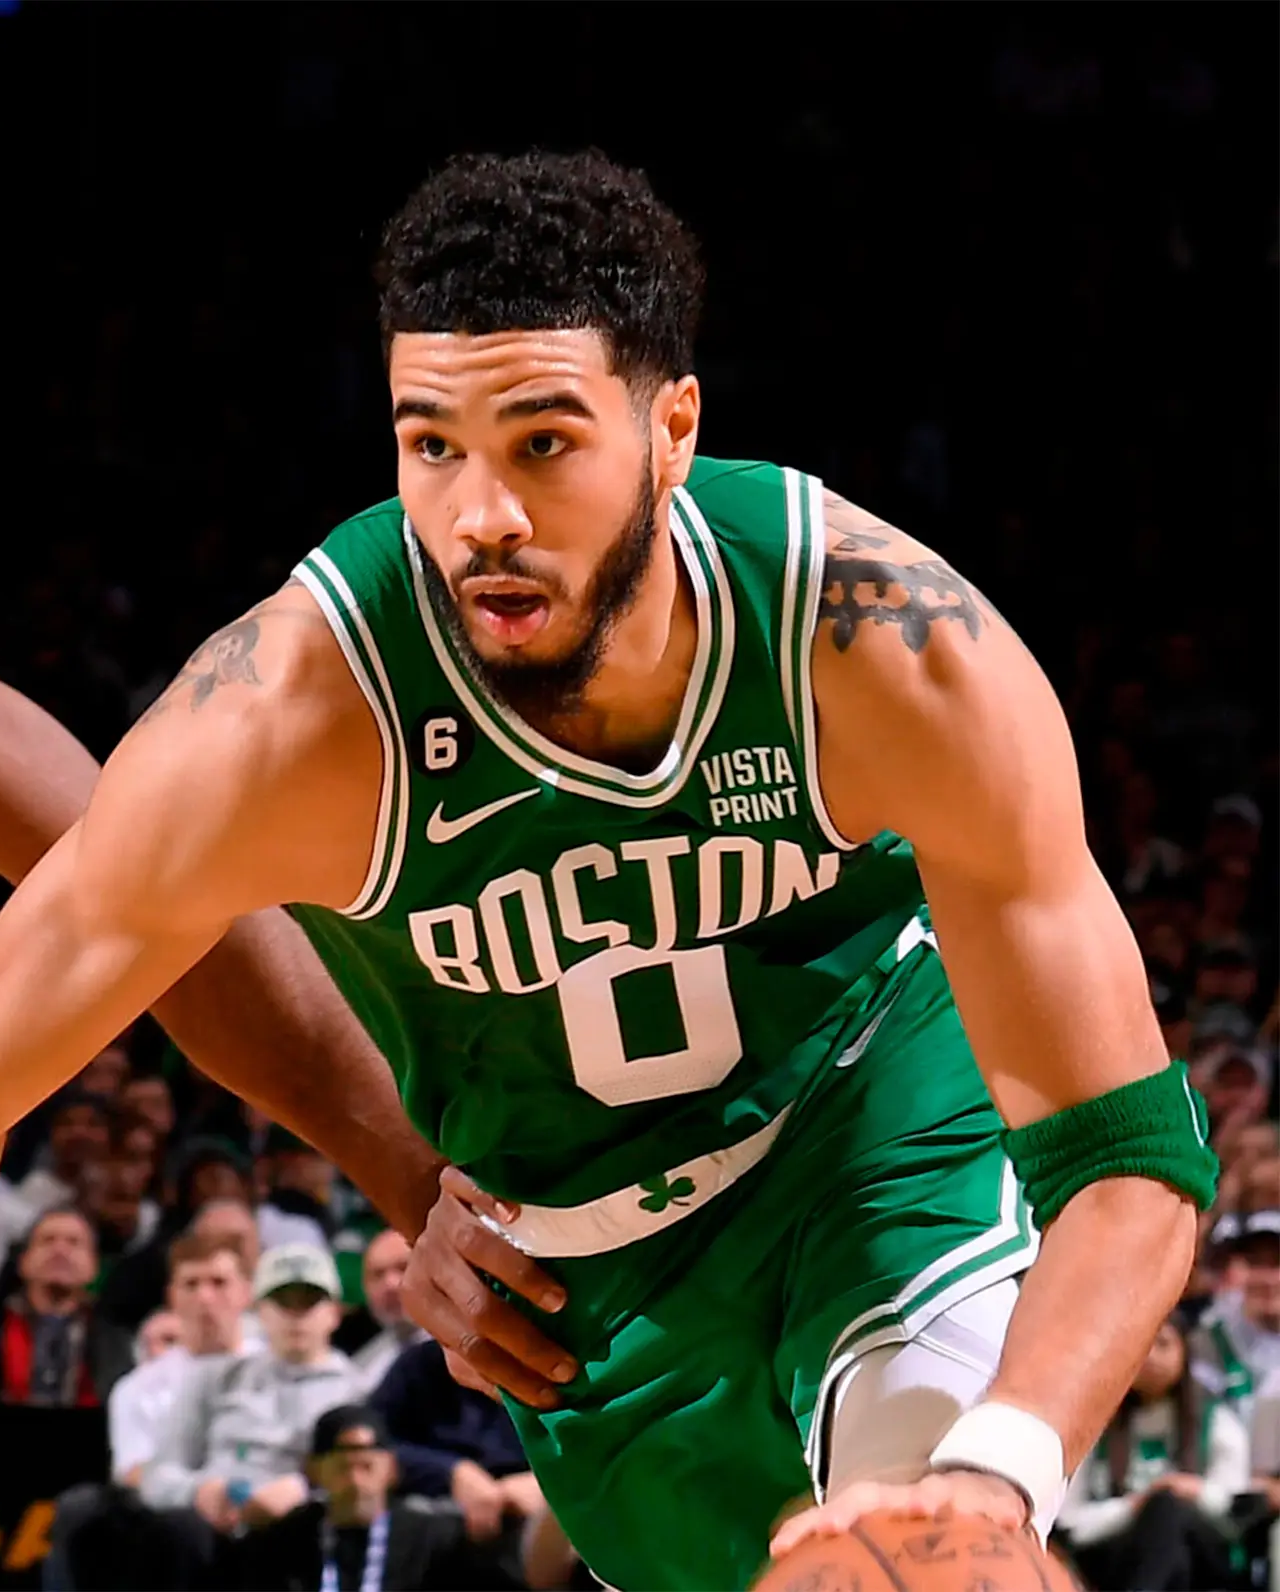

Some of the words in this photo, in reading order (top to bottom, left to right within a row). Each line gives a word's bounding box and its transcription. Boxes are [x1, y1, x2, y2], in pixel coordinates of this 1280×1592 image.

[424, 717, 459, 771] 6
[700, 747, 796, 795] VISTA
[709, 786, 798, 826] PRINT
[408, 835, 840, 994] BOSTON
[556, 944, 743, 1108] 0
